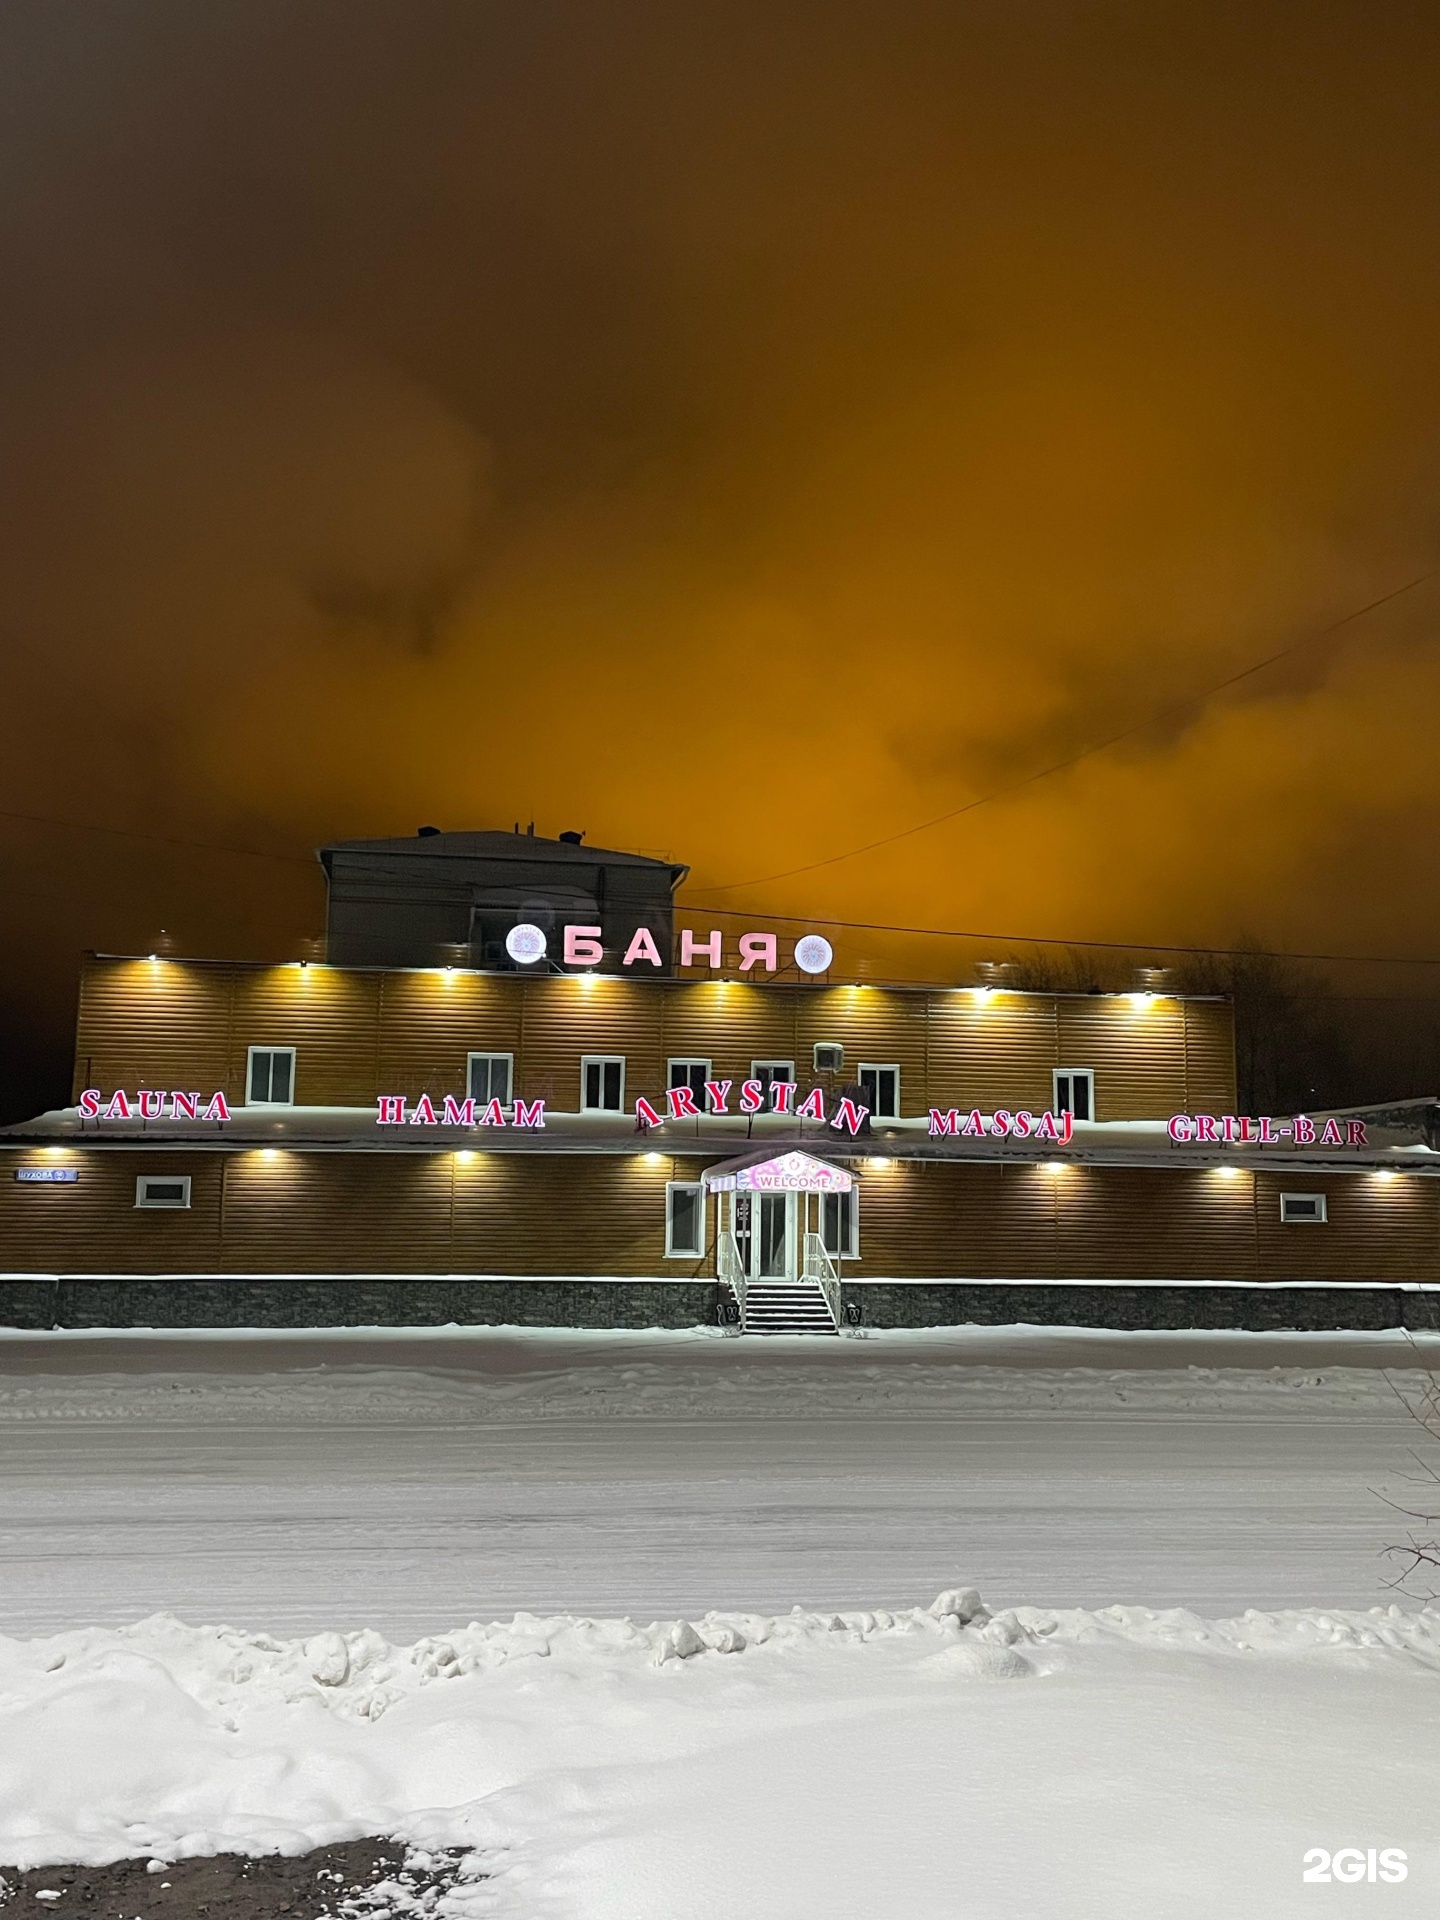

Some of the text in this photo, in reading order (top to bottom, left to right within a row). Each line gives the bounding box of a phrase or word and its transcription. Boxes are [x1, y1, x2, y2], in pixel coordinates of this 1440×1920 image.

[563, 925, 777, 971] БАНЯ
[79, 1090, 231, 1121] SAUNA
[377, 1095, 546, 1127] HAMAM
[634, 1079, 869, 1135] ARYSTAN
[929, 1109, 1074, 1145] MASSAJ
[1168, 1115, 1368, 1145] GRILL-BAR
[760, 1176, 829, 1188] WELCOME
